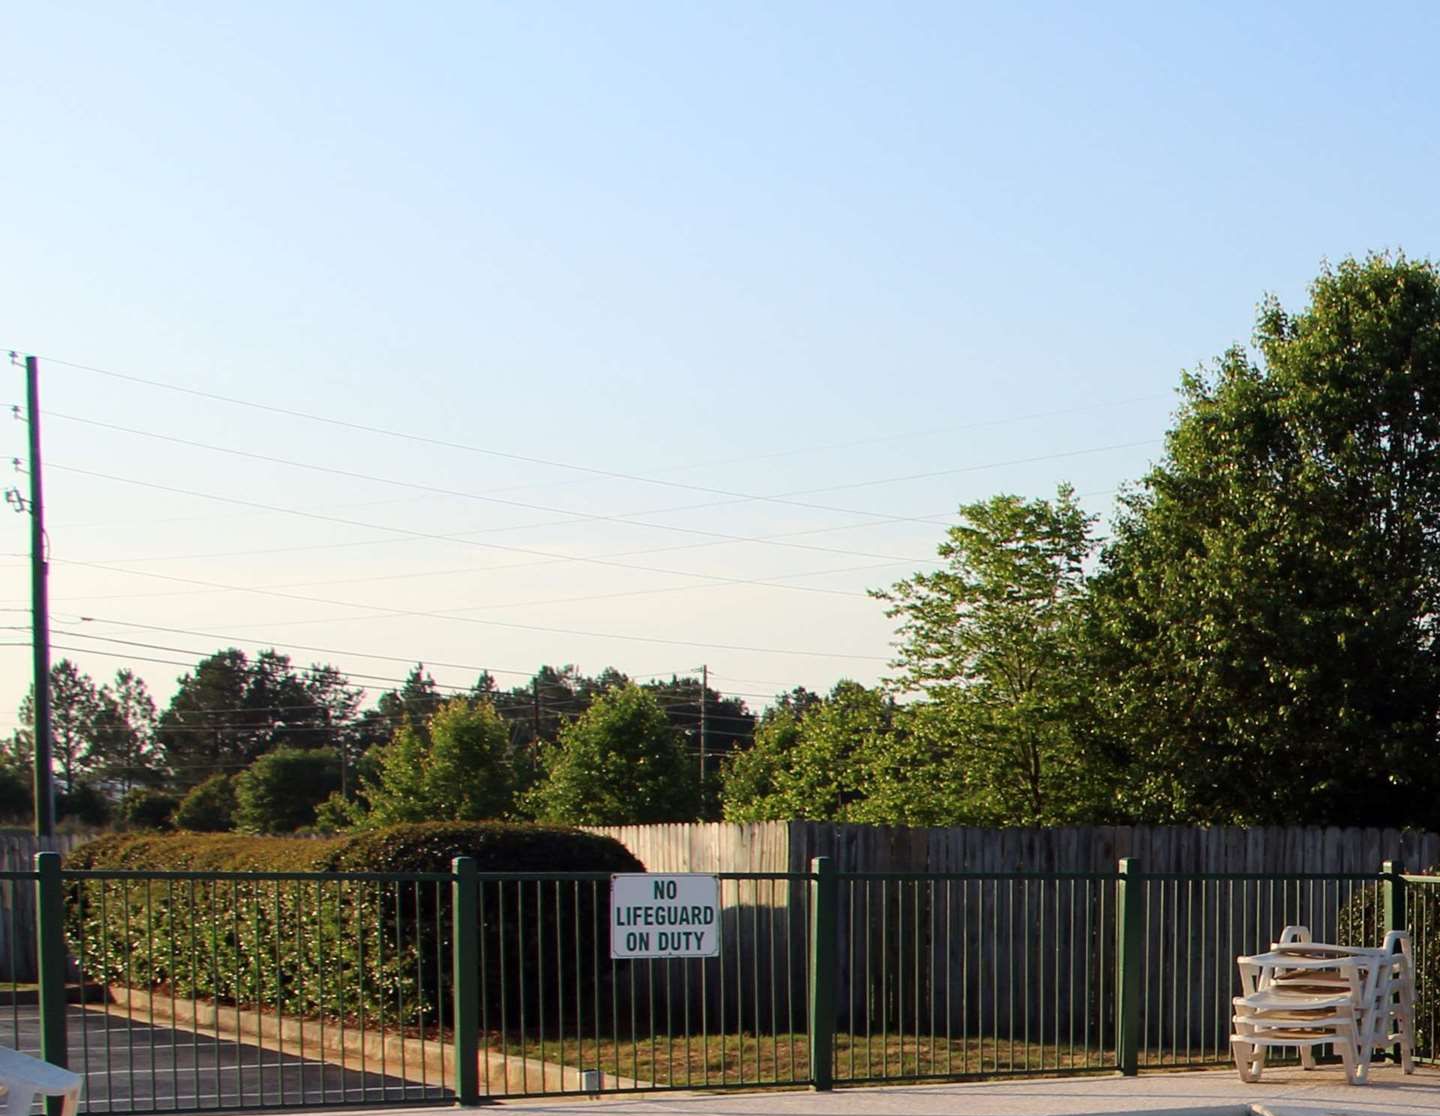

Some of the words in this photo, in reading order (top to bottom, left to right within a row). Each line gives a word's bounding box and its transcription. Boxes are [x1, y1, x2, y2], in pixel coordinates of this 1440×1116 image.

[653, 880, 677, 900] NO
[616, 906, 714, 926] LIFEGUARD
[626, 932, 650, 951] ON
[658, 932, 705, 951] DUTY
